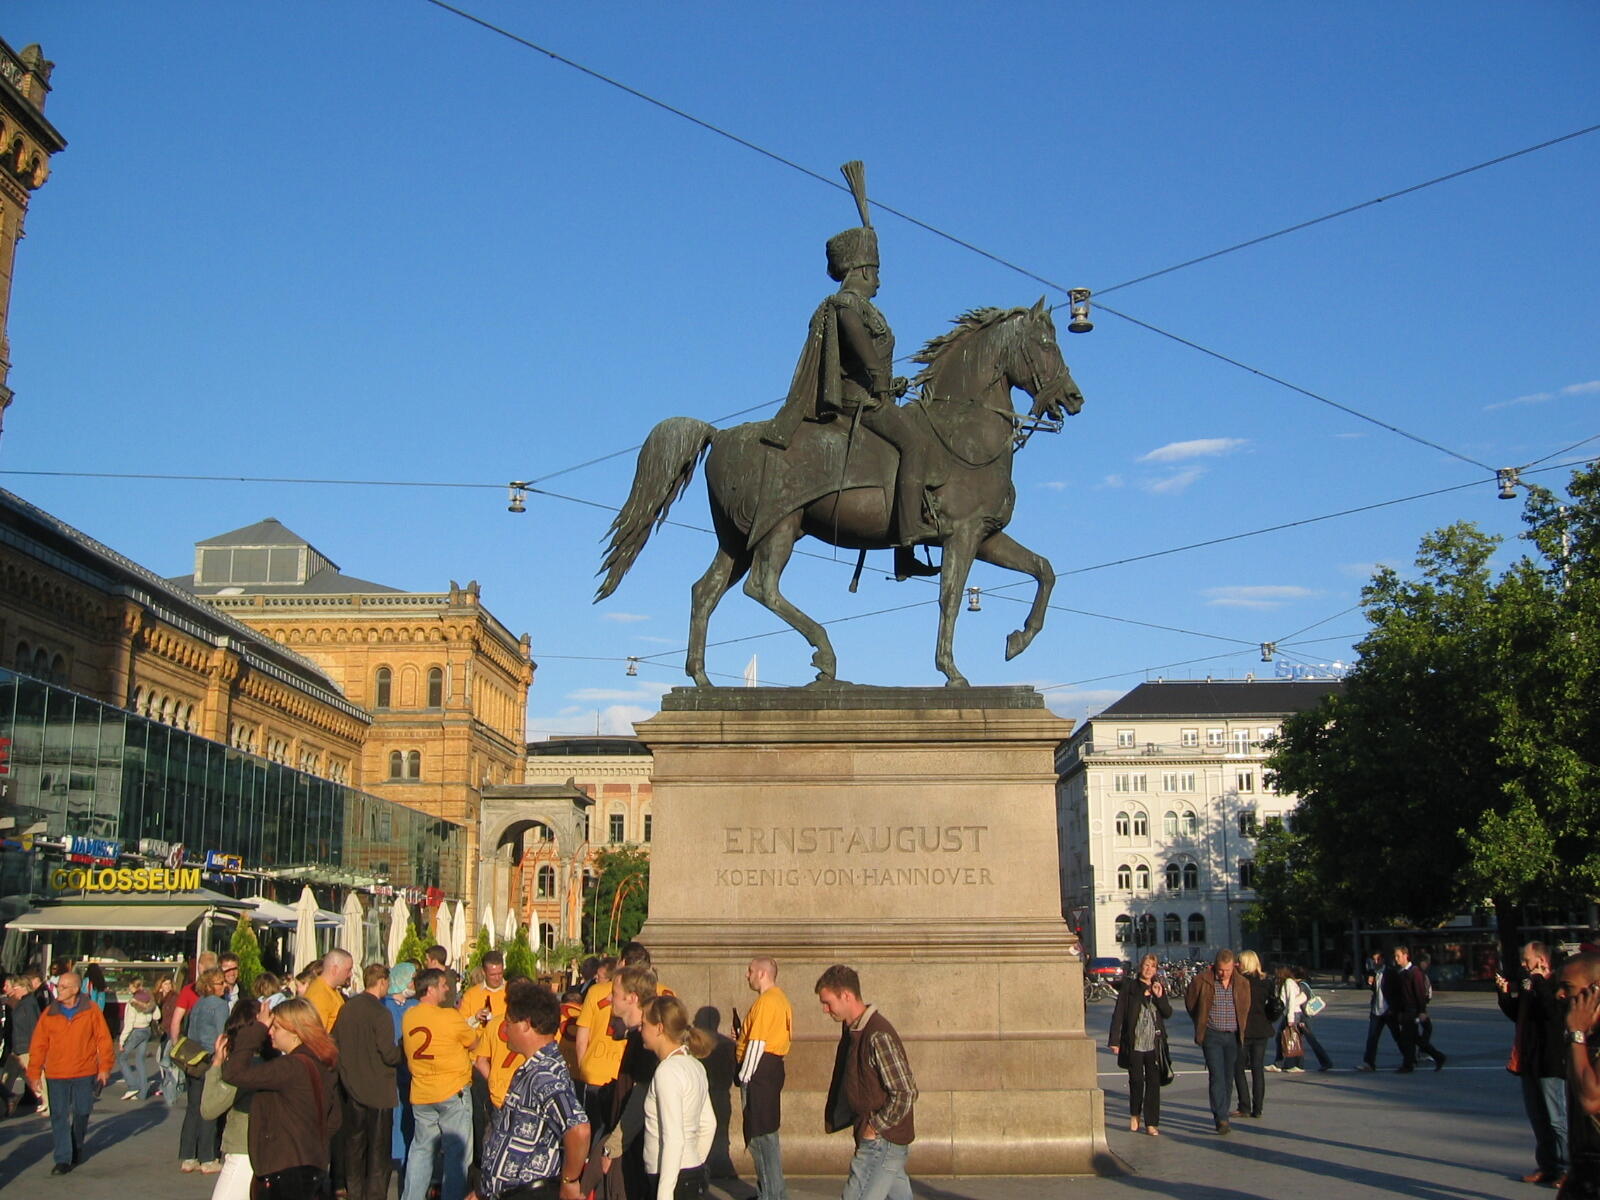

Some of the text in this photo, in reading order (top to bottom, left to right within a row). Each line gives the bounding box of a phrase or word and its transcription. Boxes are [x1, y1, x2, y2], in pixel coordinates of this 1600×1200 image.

[722, 825, 988, 854] ERNST AUGUST
[51, 868, 200, 891] COLOSSEUM
[715, 867, 993, 888] KOENIG VON HANNOVER
[408, 1026, 435, 1060] 2
